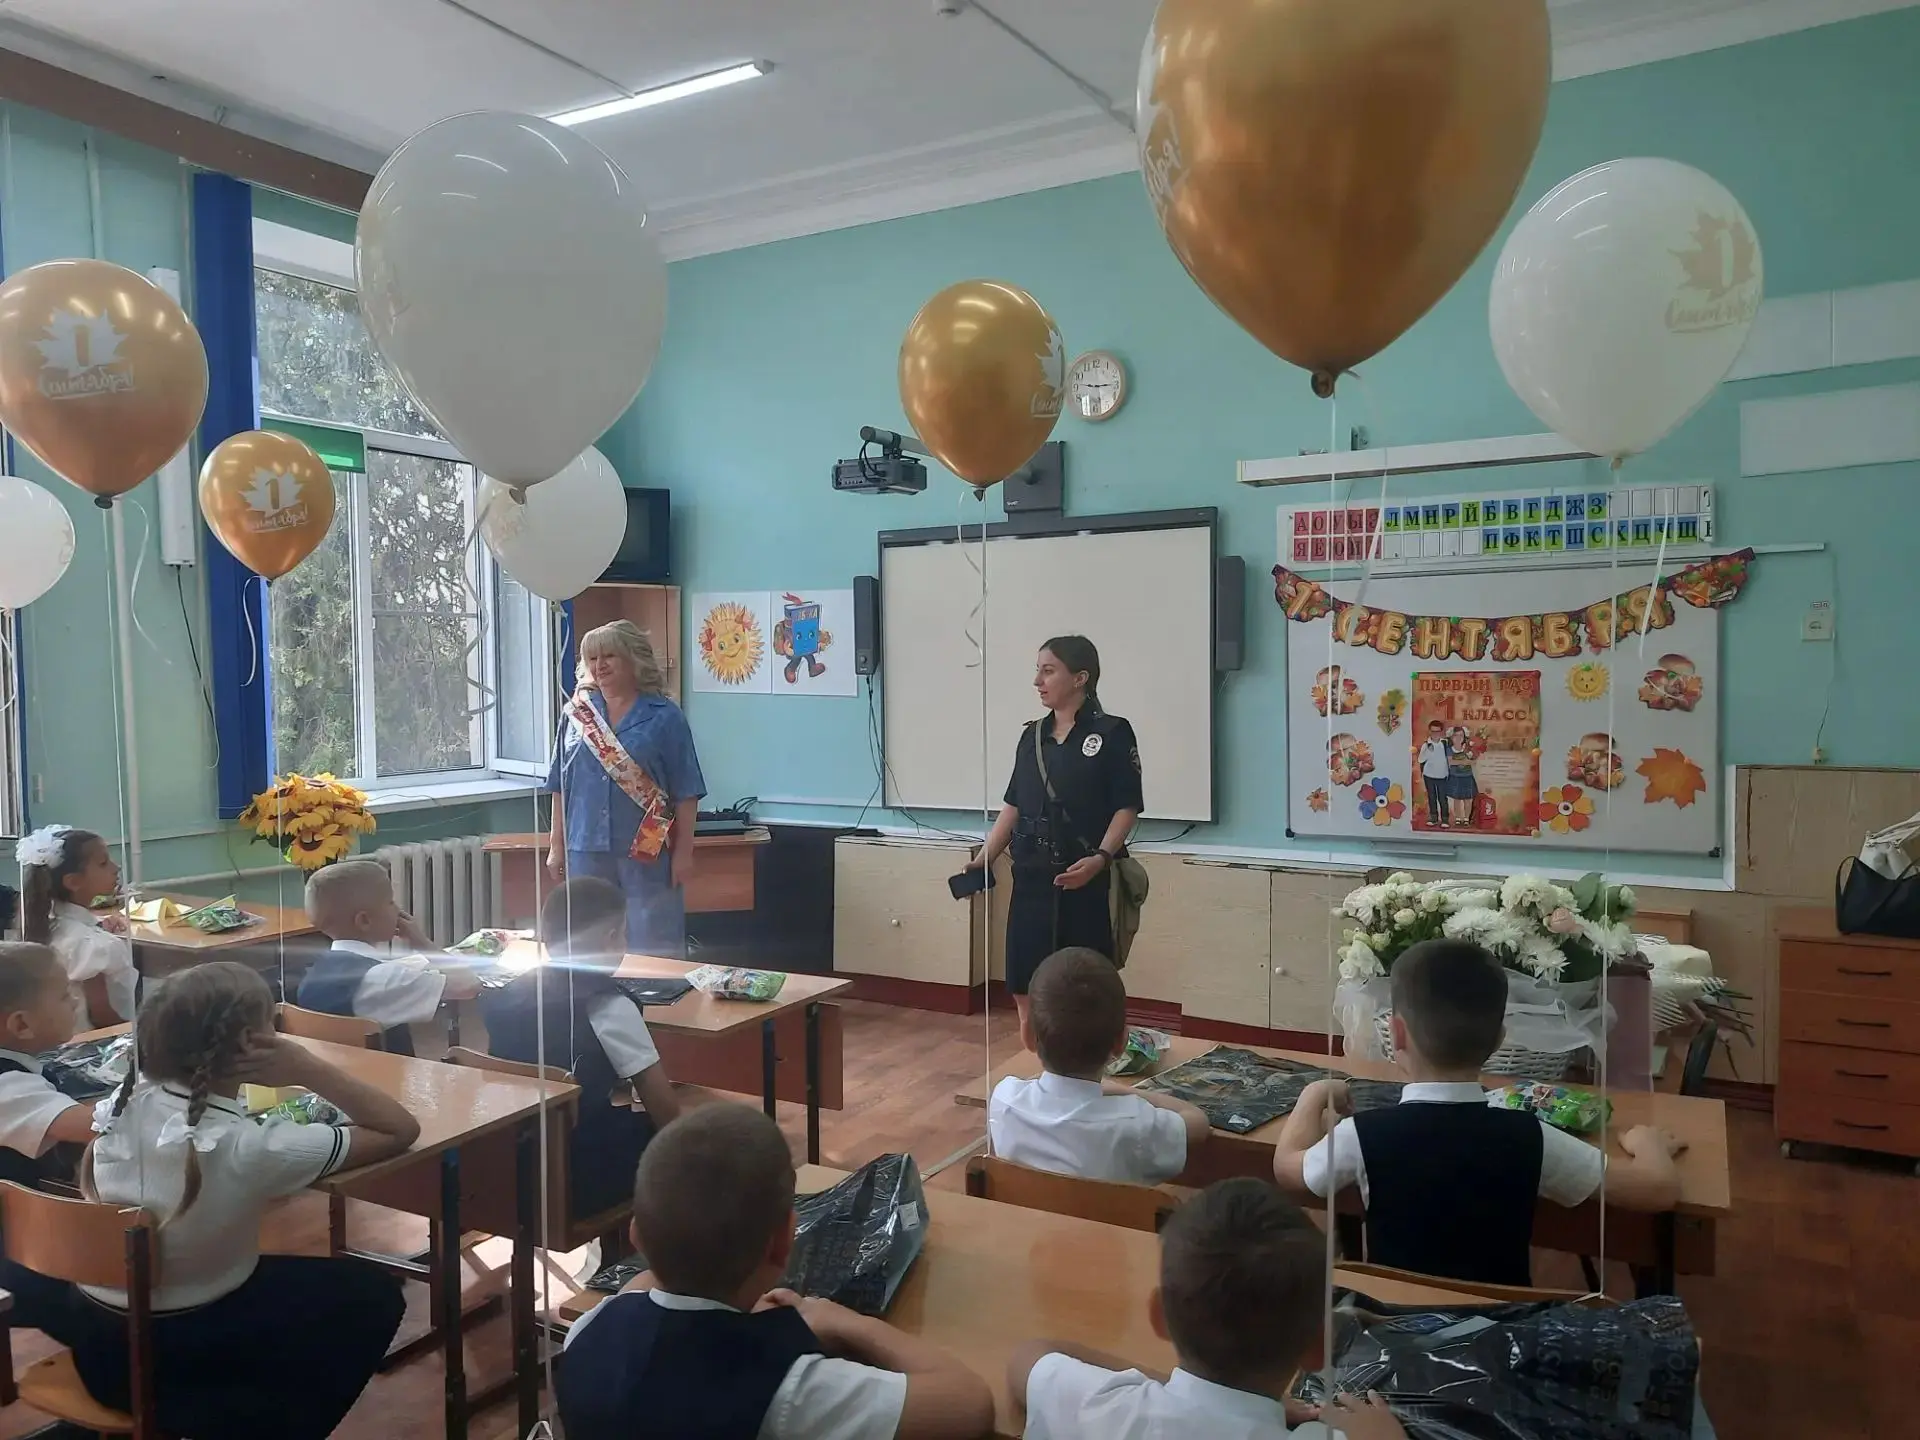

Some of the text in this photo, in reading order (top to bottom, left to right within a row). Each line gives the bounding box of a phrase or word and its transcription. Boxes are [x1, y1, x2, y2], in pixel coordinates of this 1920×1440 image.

[265, 478, 280, 510] 1
[1336, 586, 1667, 659] СЕНТЯБРЯ
[1419, 677, 1533, 692] ПЕРВЫЙ РАЗ
[1436, 696, 1455, 720] 1
[1482, 695, 1494, 707] В
